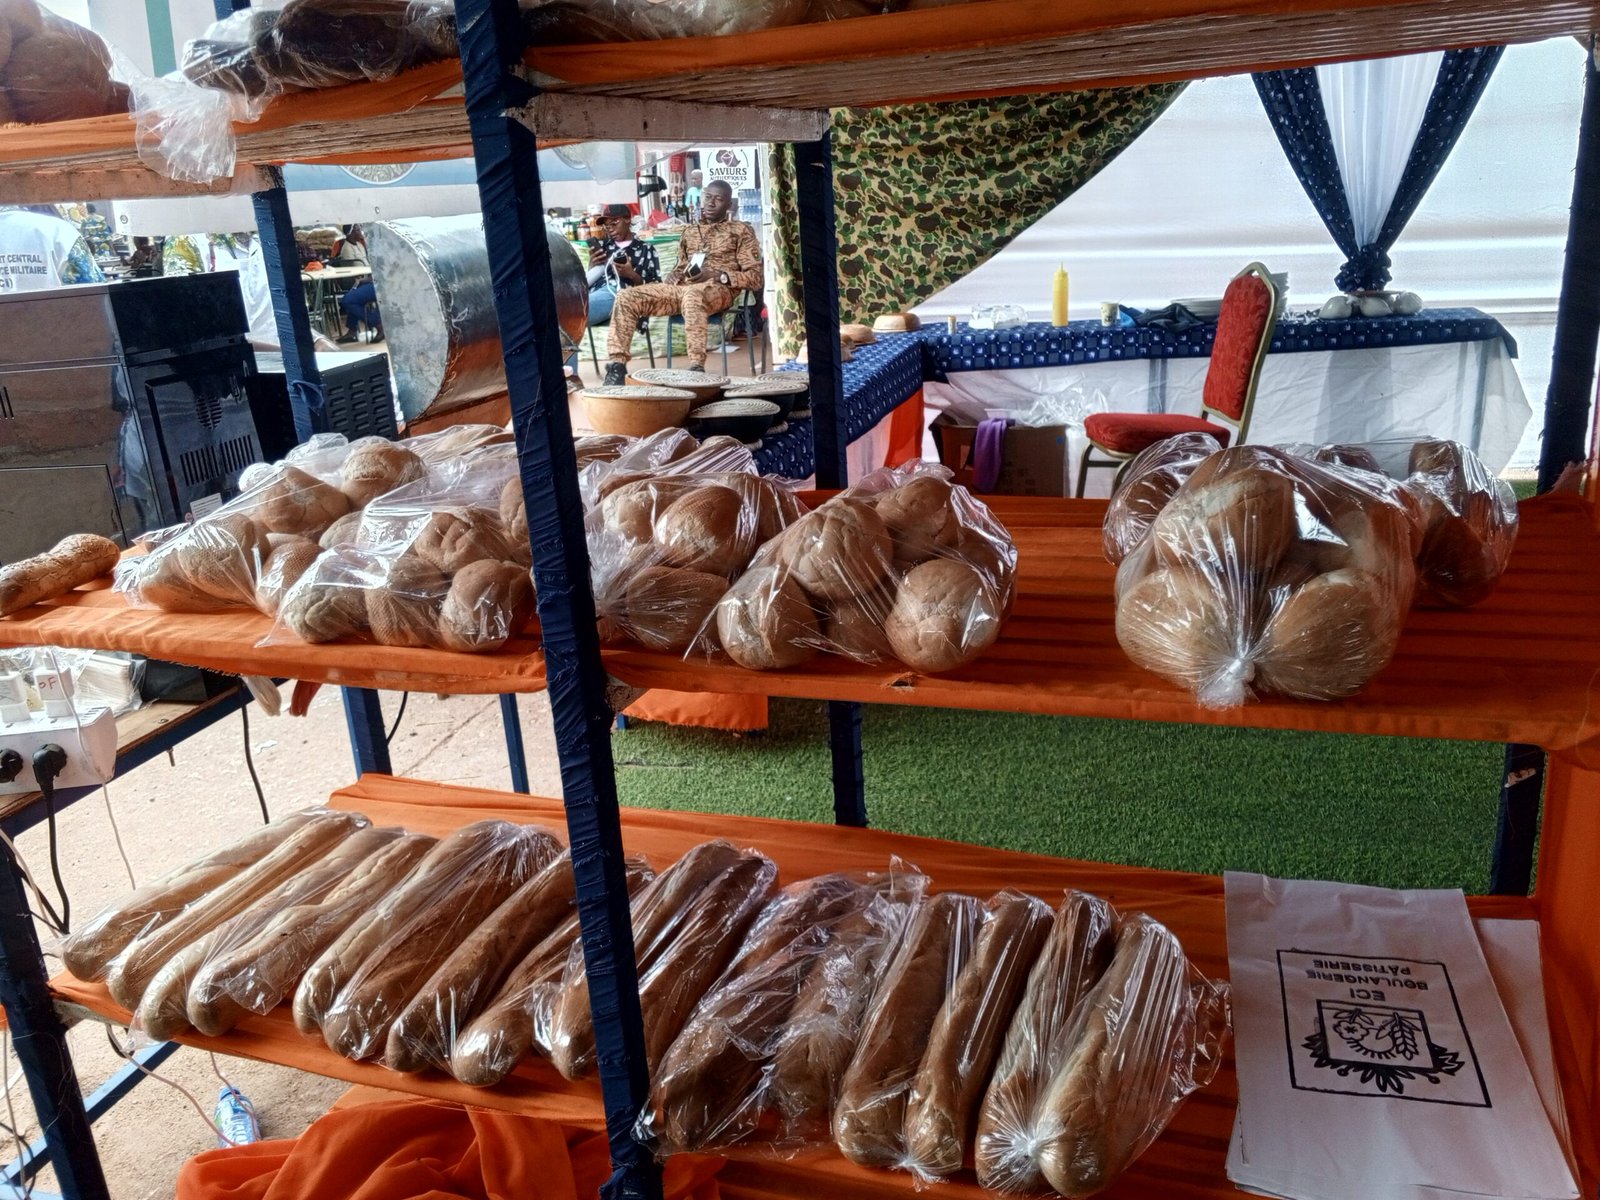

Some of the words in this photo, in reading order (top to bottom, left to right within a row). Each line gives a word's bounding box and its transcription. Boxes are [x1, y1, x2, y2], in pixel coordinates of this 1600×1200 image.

[709, 167, 747, 176] SAVIURS
[7, 254, 42, 263] CENTRAL
[10, 265, 47, 275] MILITAIRE
[1313, 959, 1411, 976] PÂTISSERIE
[1306, 969, 1428, 991] BOULANGERIE
[1349, 988, 1386, 1001] ECI
